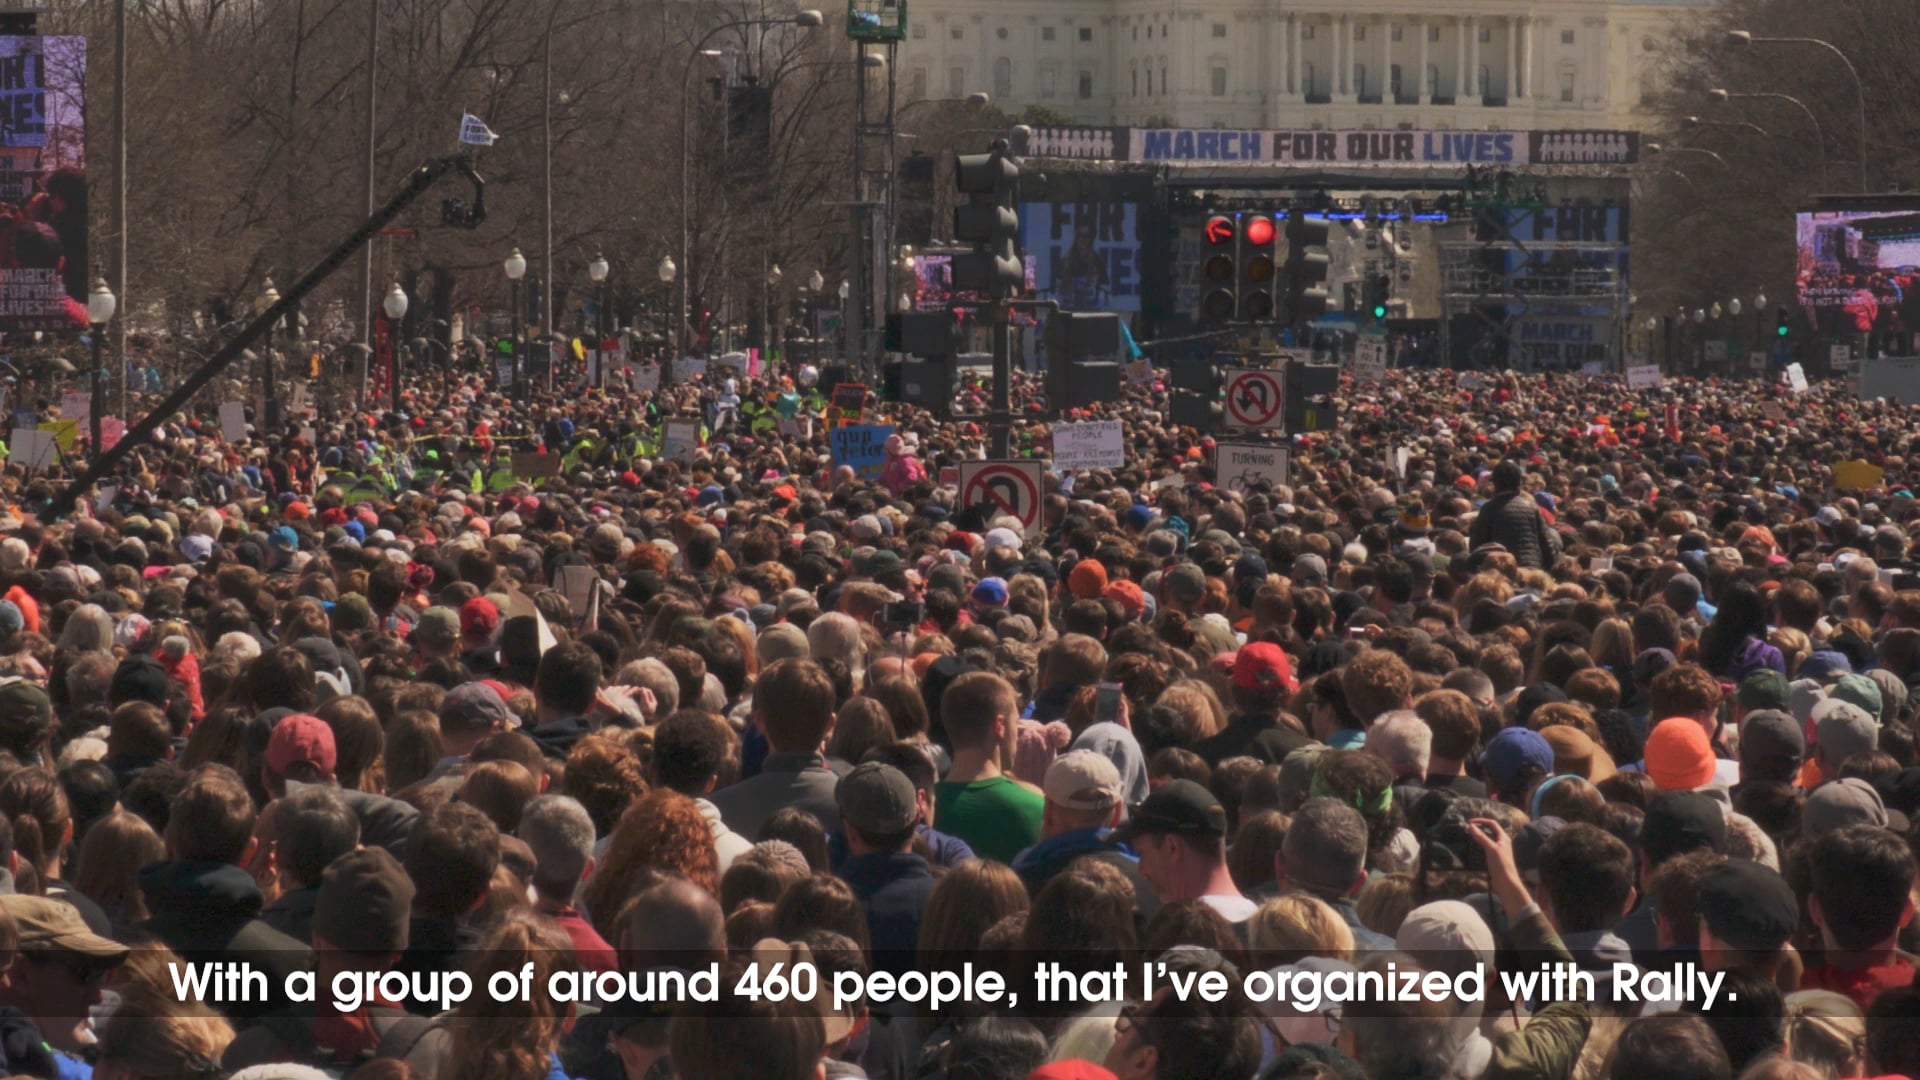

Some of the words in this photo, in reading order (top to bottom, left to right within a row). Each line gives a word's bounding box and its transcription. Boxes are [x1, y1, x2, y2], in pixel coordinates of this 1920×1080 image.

[1144, 131, 1261, 161] MARCH
[1273, 132, 1337, 161] FOR
[1347, 132, 1414, 161] OUR
[1422, 132, 1513, 161] LIVES
[1521, 323, 1593, 341] MARCH
[1232, 452, 1275, 466] TURNING
